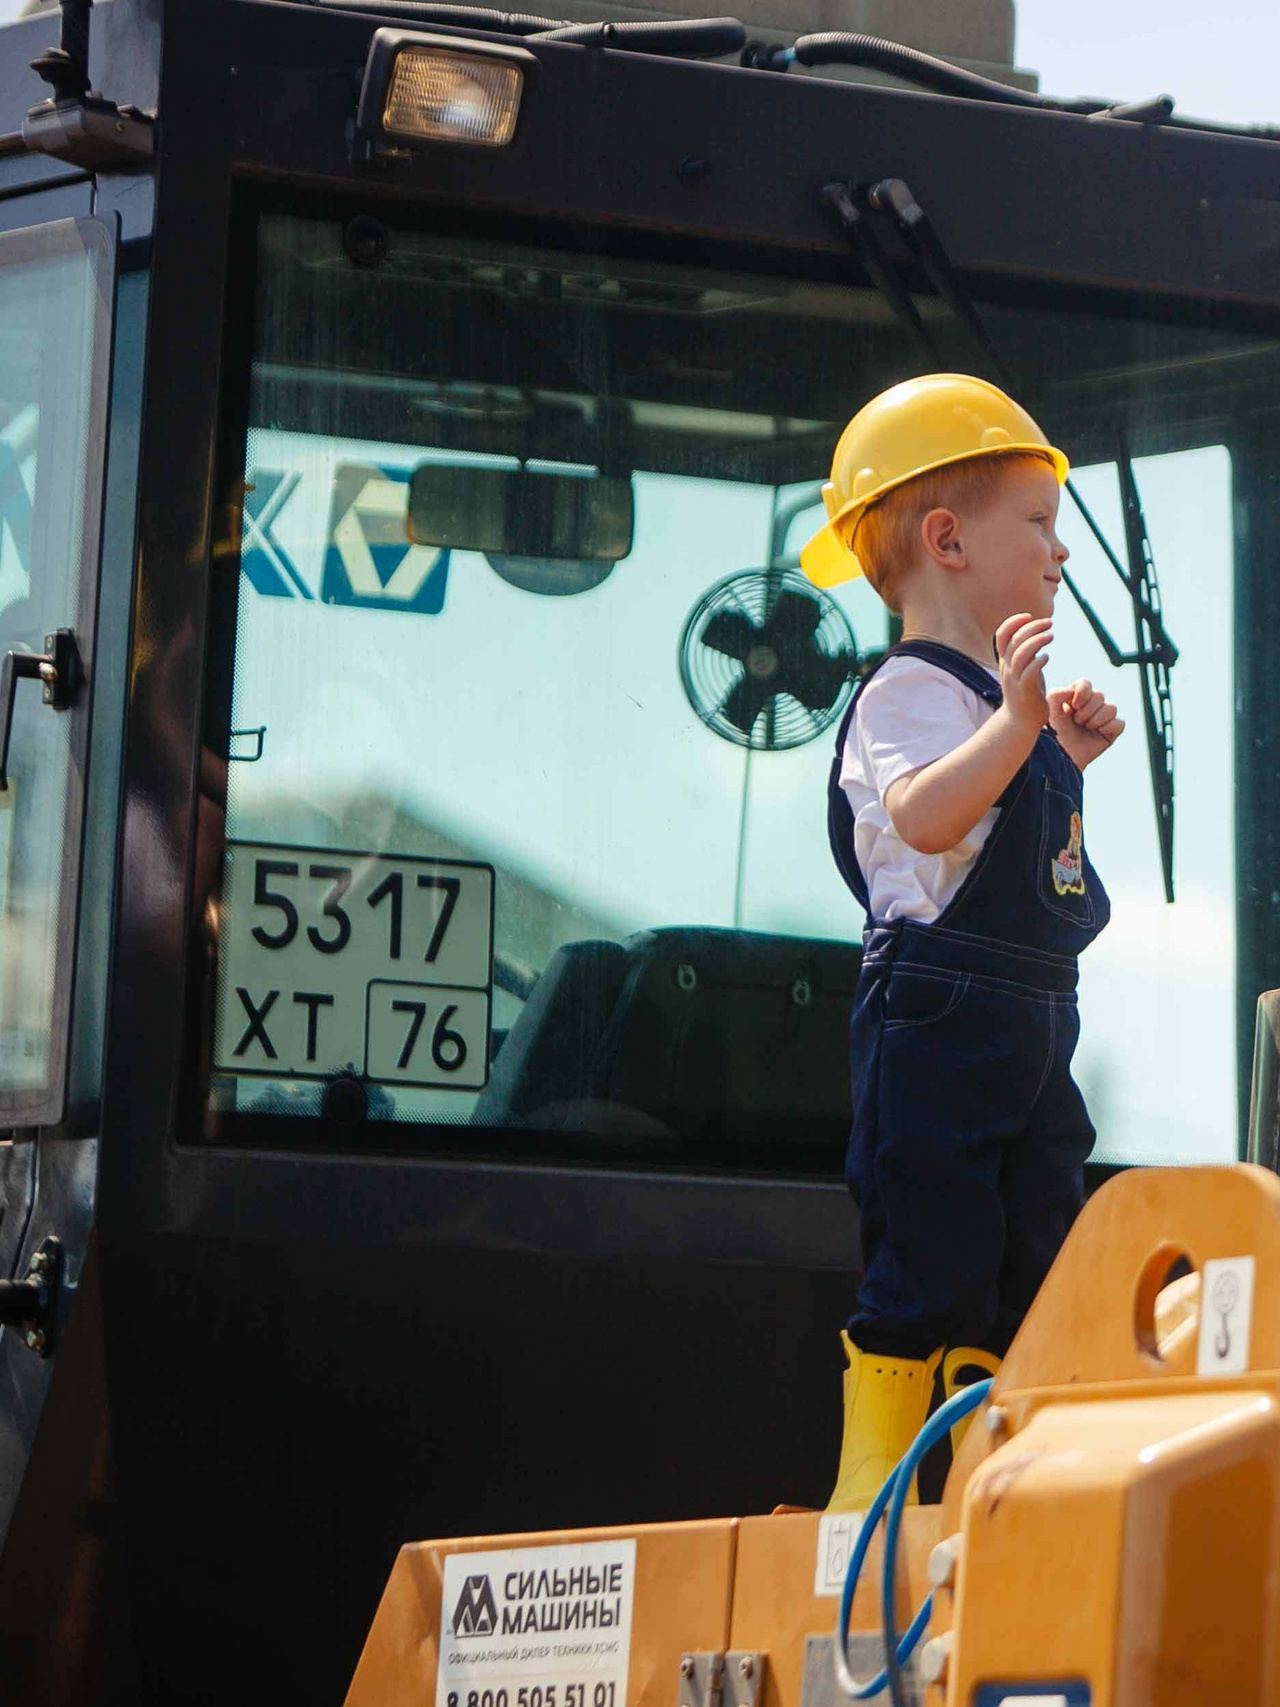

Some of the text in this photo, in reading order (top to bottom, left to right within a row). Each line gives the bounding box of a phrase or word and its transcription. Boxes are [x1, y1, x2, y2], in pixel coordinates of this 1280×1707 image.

[251, 859, 460, 963] 5317
[391, 1000, 467, 1071] 76
[504, 1563, 622, 1601] СИЛЬНЫЕ
[501, 1597, 621, 1635] МАШИНЫ
[467, 1687, 508, 1707] 800
[517, 1685, 556, 1707] 505
[565, 1682, 585, 1707] 51
[594, 1680, 616, 1707] 01
